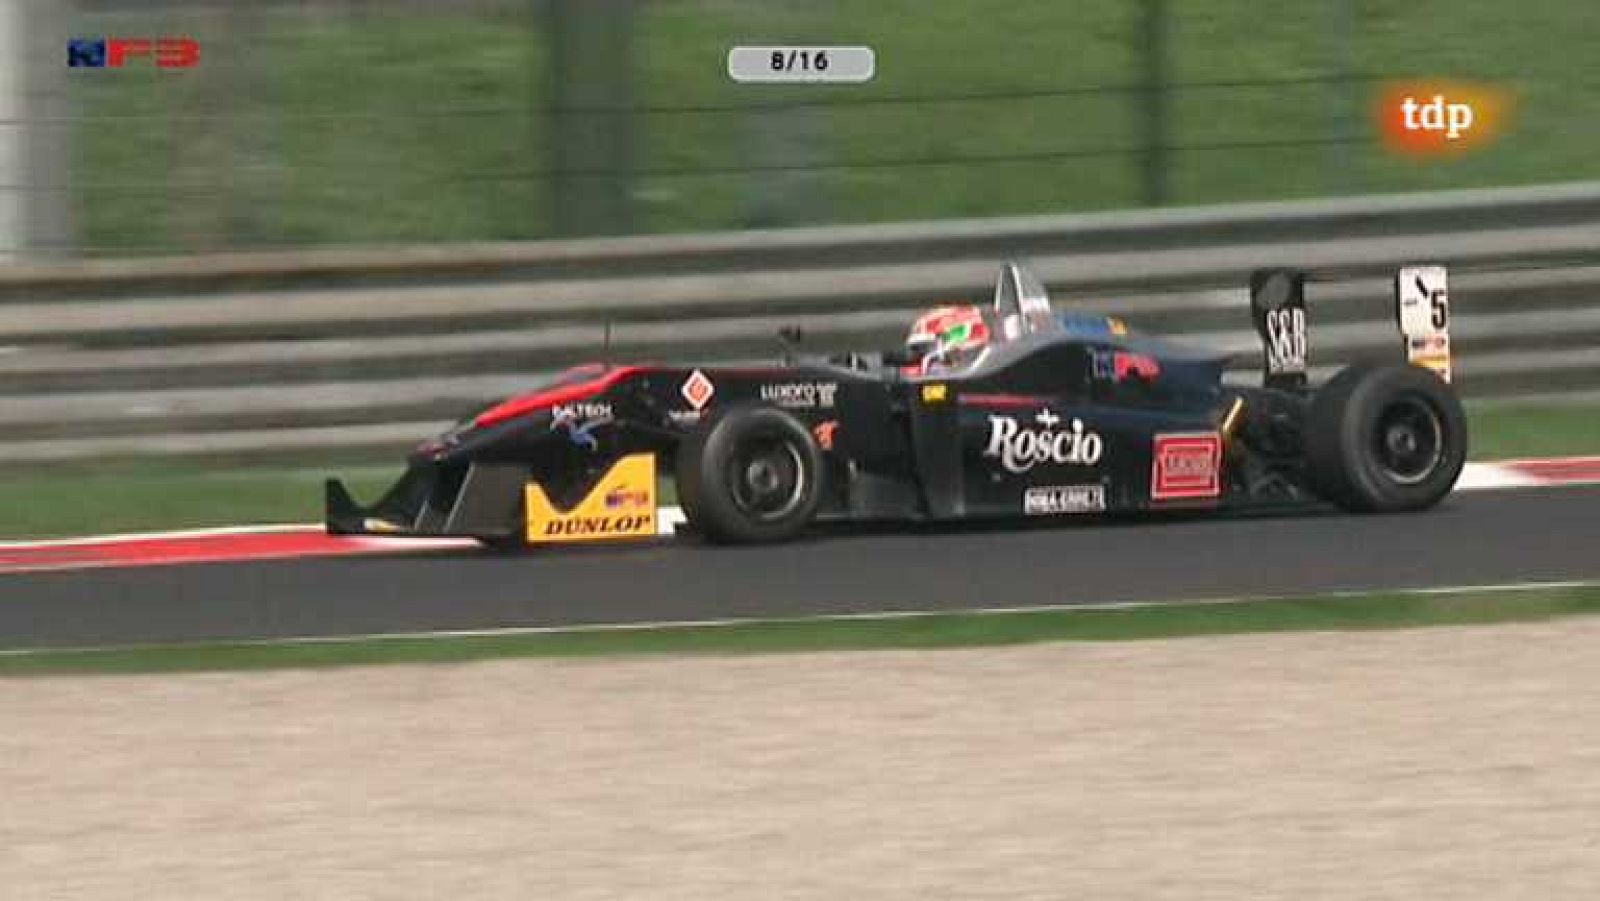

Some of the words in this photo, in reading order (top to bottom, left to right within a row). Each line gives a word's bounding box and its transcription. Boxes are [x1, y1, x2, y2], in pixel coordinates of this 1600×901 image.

[1431, 290, 1446, 328] 5
[985, 414, 1102, 471] Roscio
[543, 514, 652, 535] DUNLOP
